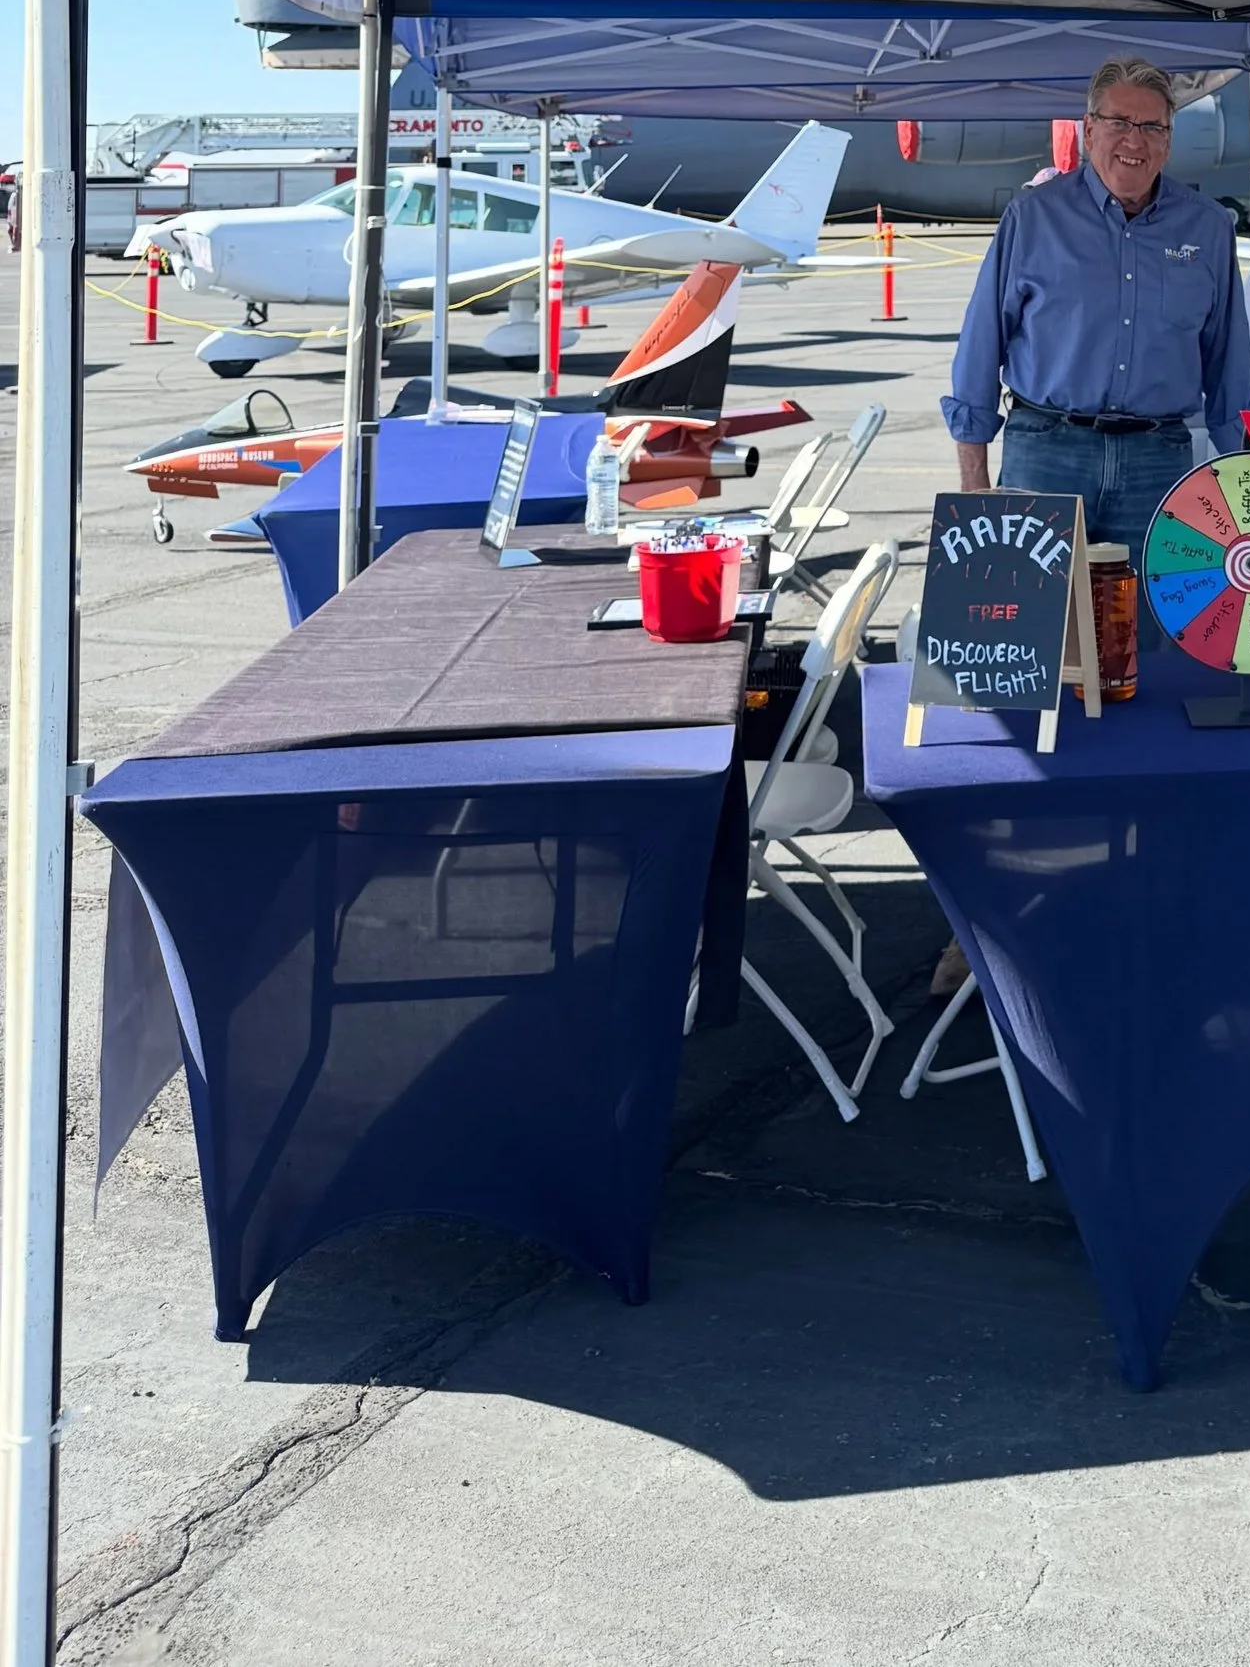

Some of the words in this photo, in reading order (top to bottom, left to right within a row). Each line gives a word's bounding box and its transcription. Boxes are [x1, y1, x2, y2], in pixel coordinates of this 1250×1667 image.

[1165, 248, 1191, 259] MACH
[242, 450, 275, 461] MUSEUM
[1239, 470, 1250, 486] Tix
[1197, 495, 1231, 535] Sticker
[940, 514, 1072, 575] RAFFLE
[1162, 540, 1179, 556] Tix
[1180, 545, 1214, 562] Raffle
[1183, 576, 1216, 591] Swag
[1160, 593, 1185, 603] Bag
[968, 604, 1019, 622] FREE
[1203, 600, 1234, 642] Sticker
[927, 635, 1037, 672] DISCOVERY
[955, 665, 1047, 697] FLIGHT!
